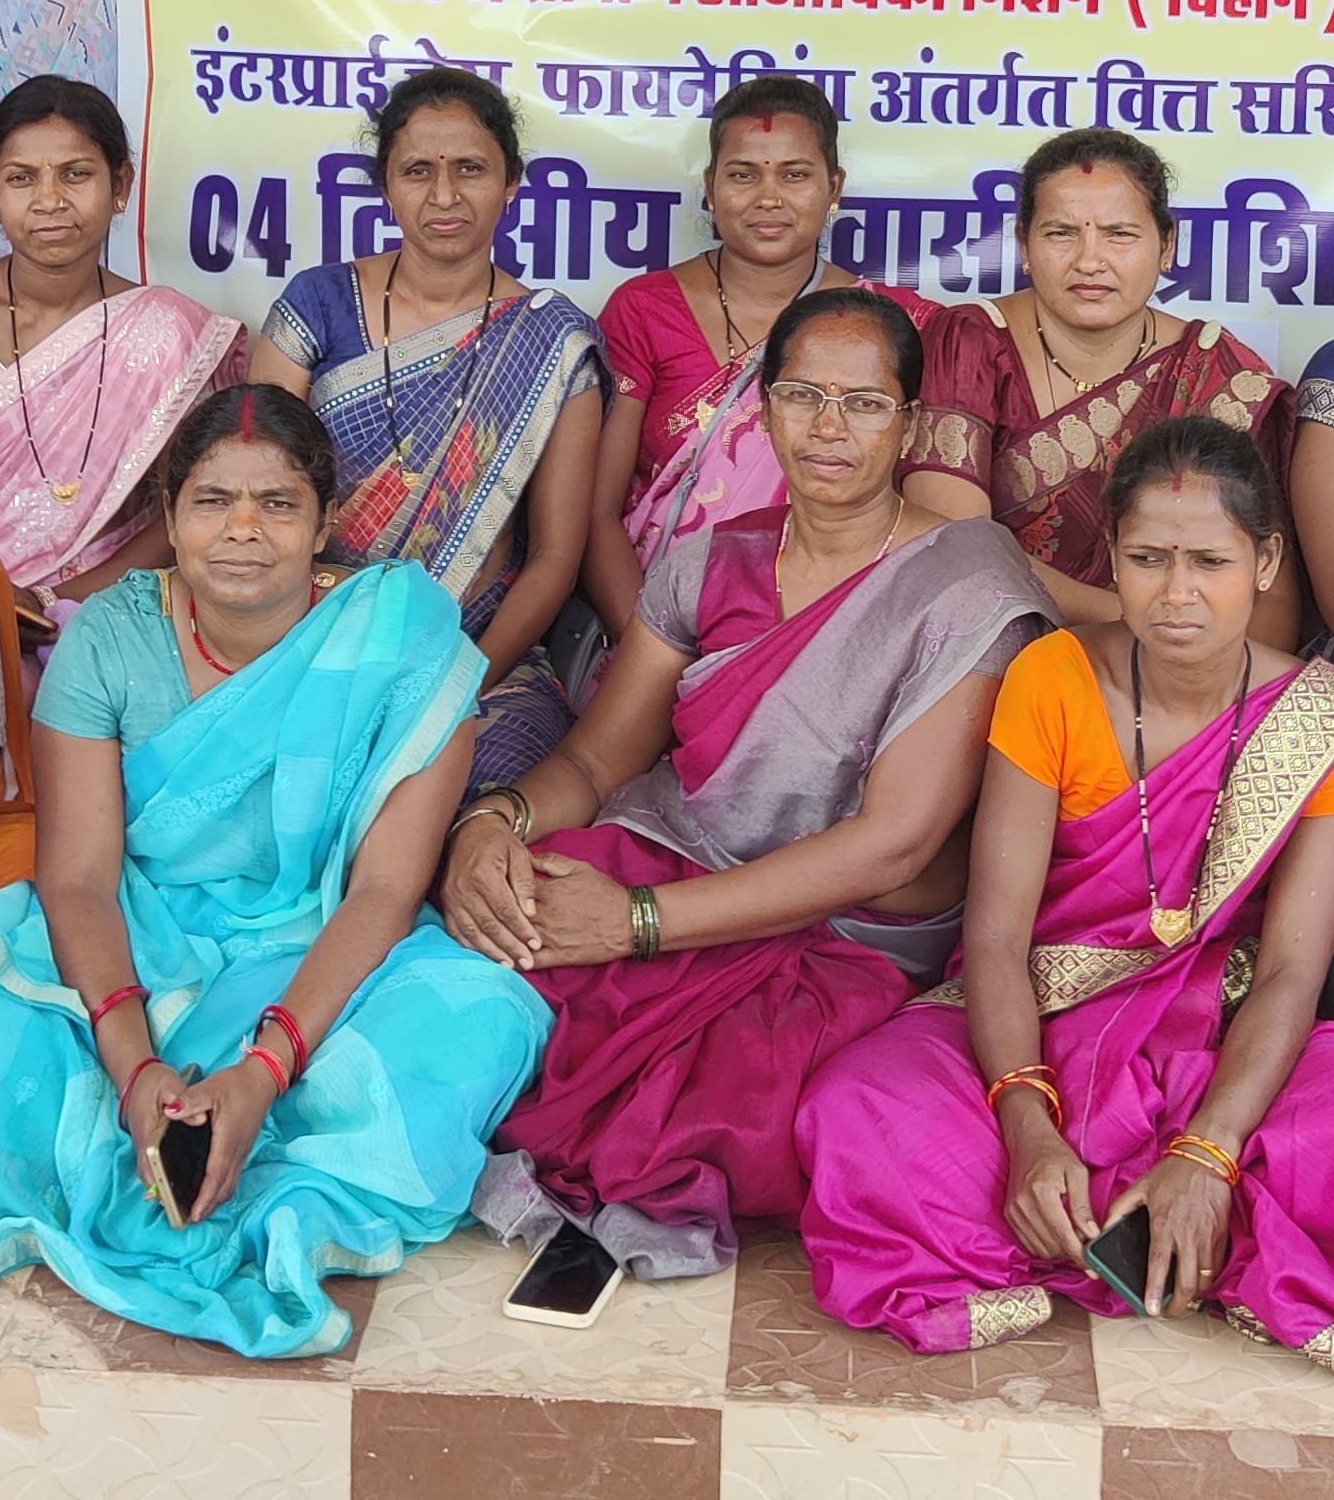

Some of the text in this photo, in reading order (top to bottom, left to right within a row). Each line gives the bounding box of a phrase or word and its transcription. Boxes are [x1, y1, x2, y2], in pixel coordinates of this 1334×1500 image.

[871, 47, 1075, 130] अंतर्गत
[1089, 60, 1218, 134] वित्त
[189, 174, 292, 279] 04
